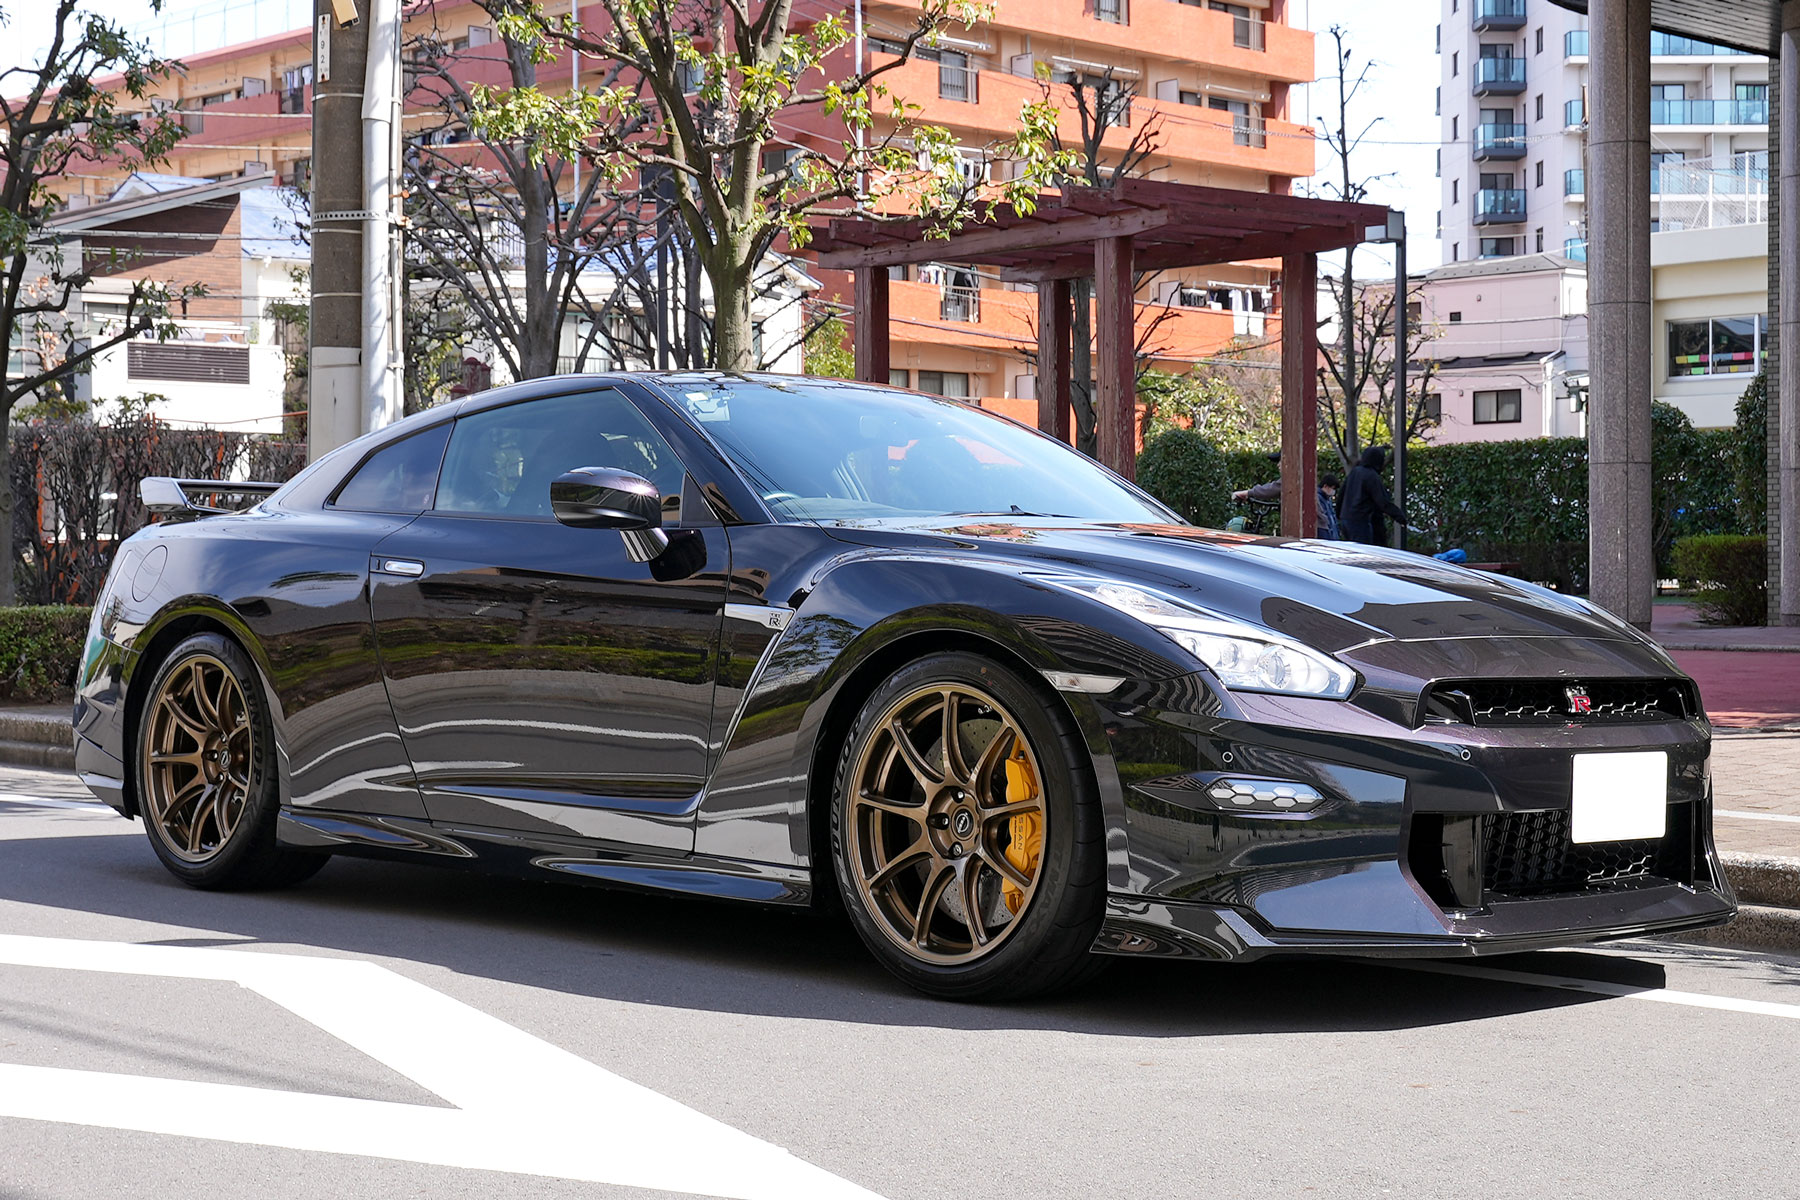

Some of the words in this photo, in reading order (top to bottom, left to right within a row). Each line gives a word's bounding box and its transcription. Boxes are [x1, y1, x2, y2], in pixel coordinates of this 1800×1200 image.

[241, 678, 262, 786] DUNLOP
[831, 719, 859, 858] DUNLOP
[1017, 816, 1025, 851] SSAN
